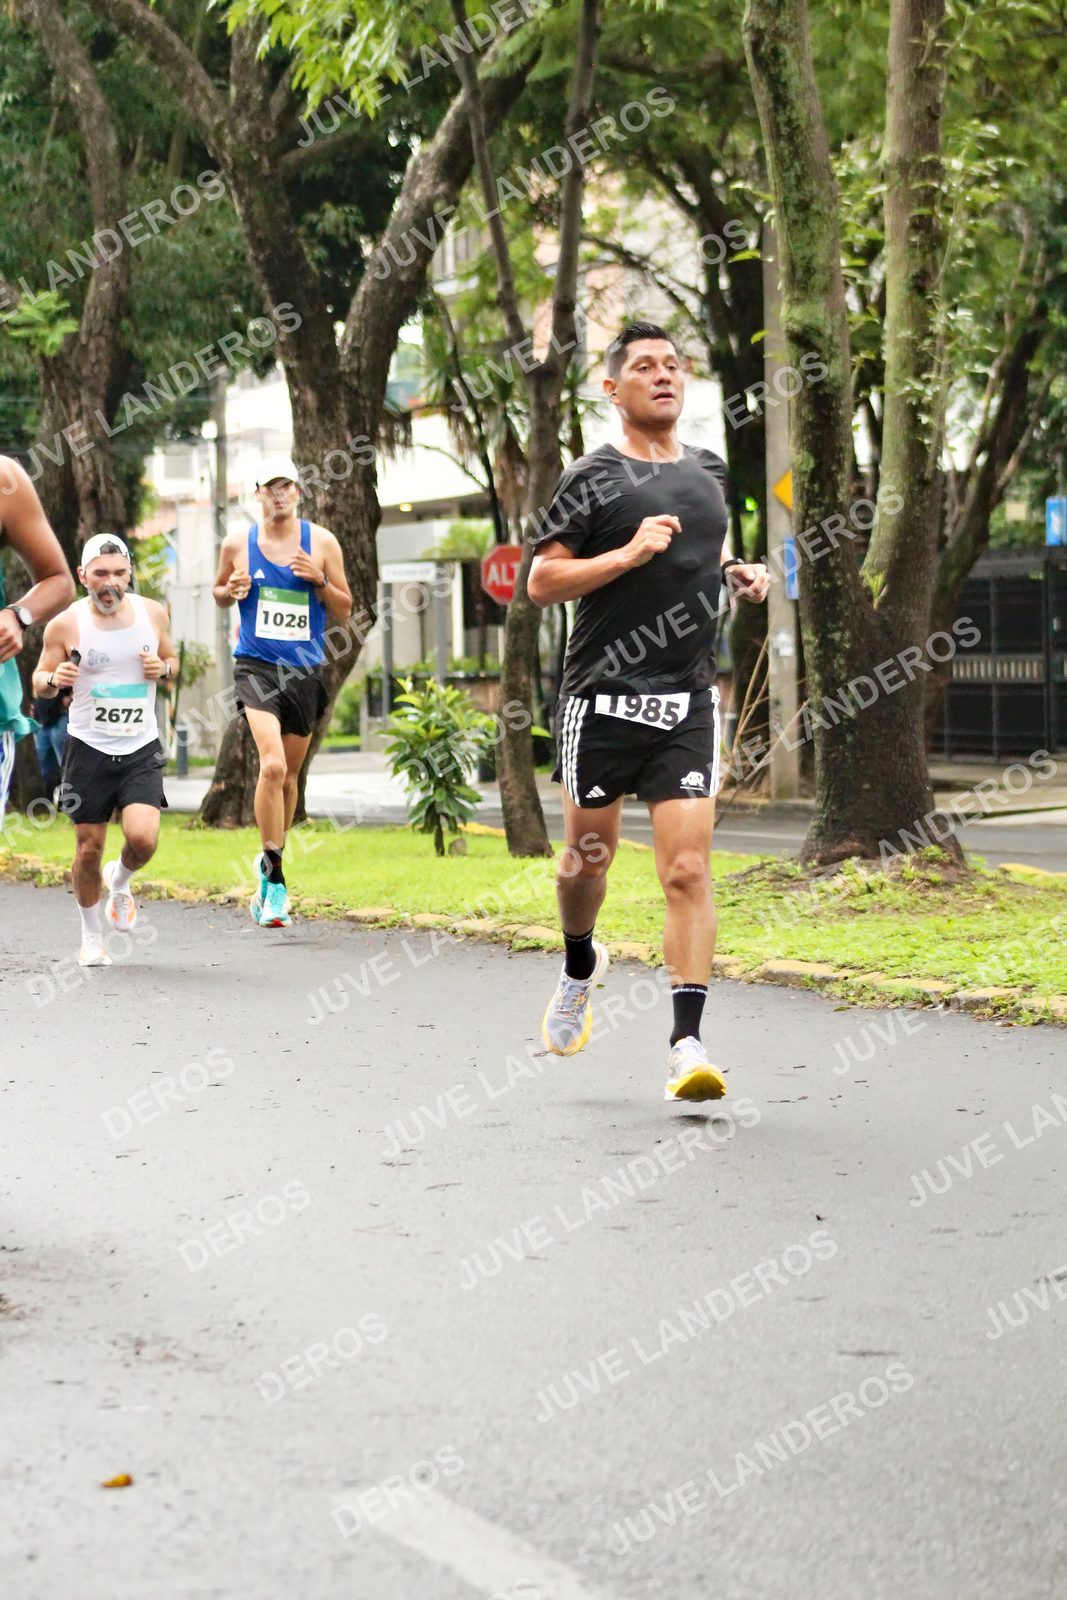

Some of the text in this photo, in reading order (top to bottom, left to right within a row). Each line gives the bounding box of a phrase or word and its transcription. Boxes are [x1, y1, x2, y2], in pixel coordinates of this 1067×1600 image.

[488, 564, 521, 586] ALT
[263, 610, 308, 629] 1028
[95, 707, 143, 723] 2672
[609, 695, 681, 727] 1985
